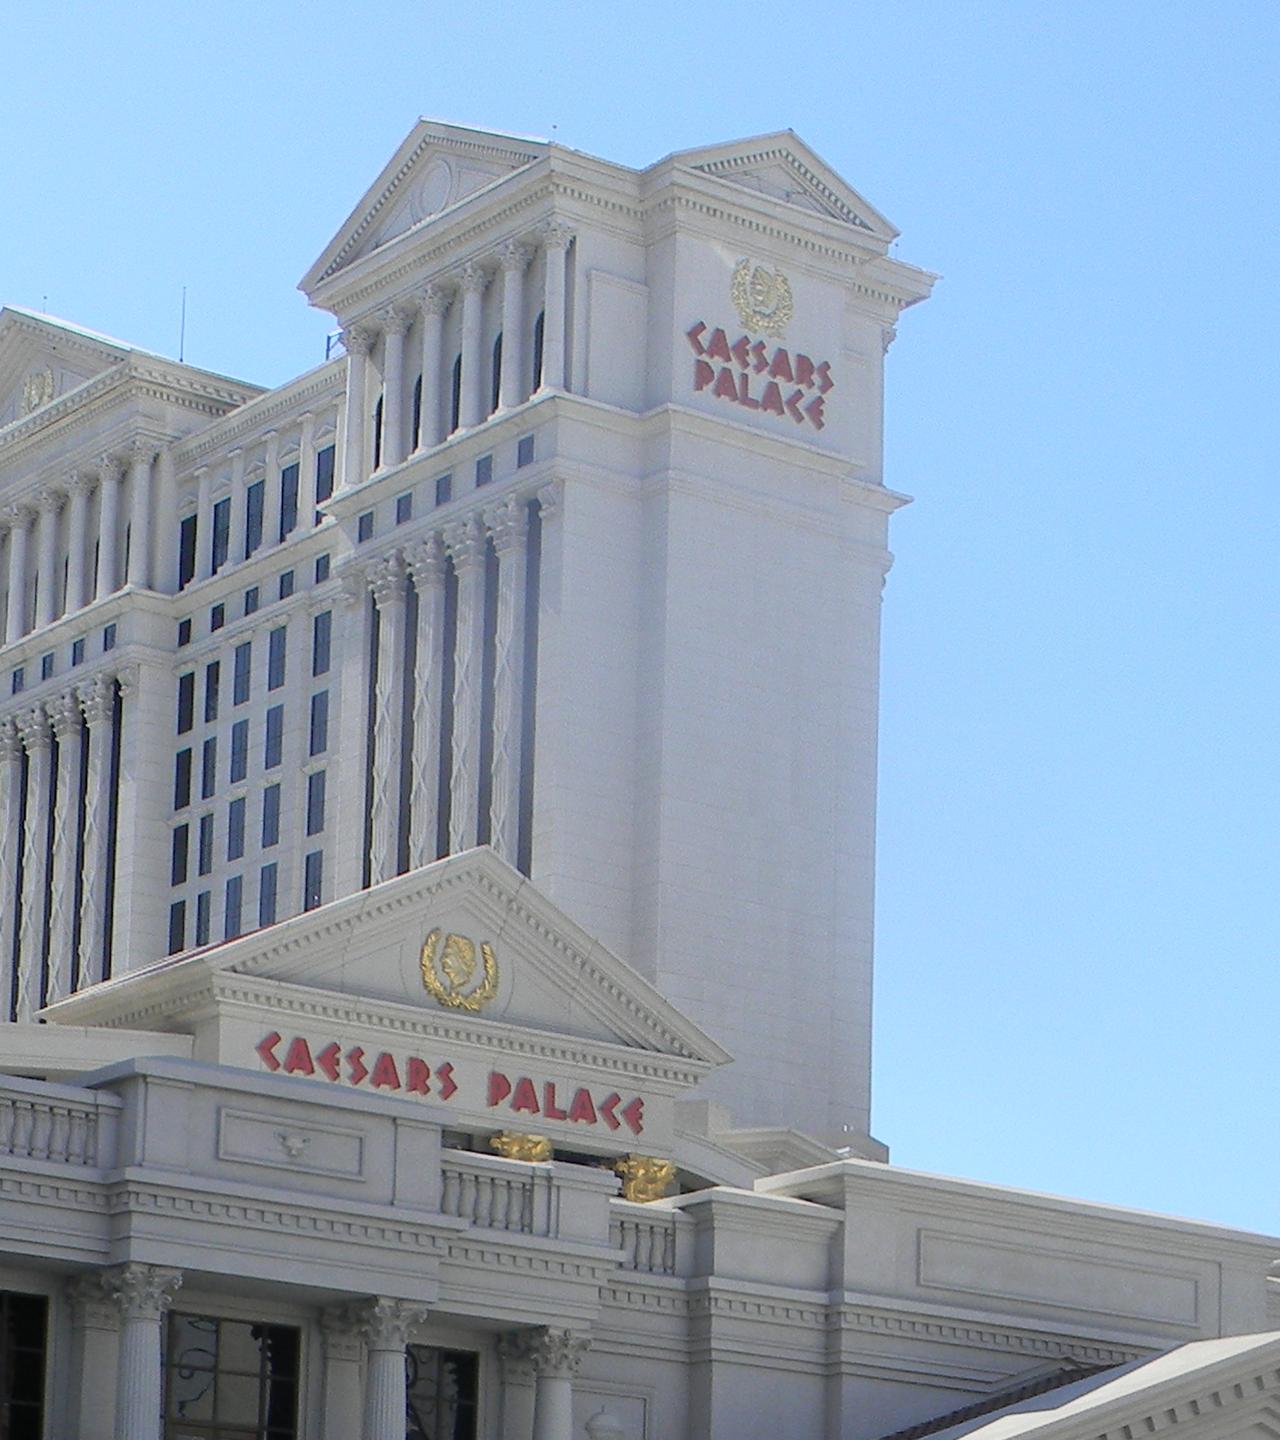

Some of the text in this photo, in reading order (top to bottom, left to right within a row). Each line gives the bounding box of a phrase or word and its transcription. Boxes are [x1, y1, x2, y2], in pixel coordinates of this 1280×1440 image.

[686, 321, 834, 394] CAESARS
[694, 359, 825, 430] PALACE
[255, 1031, 645, 1135] CAESARS PALACE
